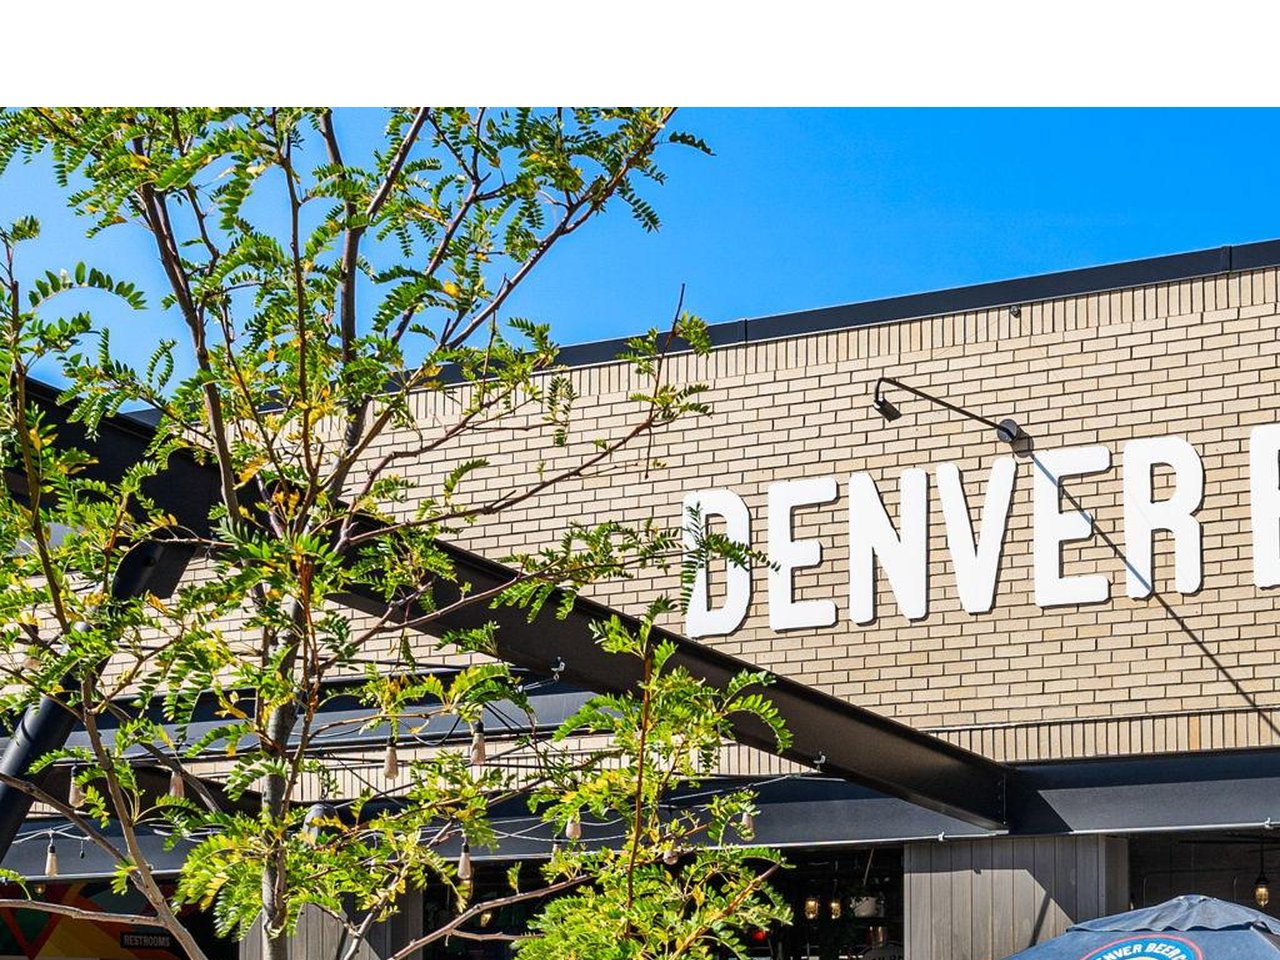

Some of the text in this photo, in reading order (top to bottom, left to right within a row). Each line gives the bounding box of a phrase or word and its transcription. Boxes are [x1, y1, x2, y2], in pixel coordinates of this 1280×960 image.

[682, 435, 1205, 638] DENVER
[123, 934, 170, 947] RESTROOMS
[1144, 942, 1181, 959] BEER
